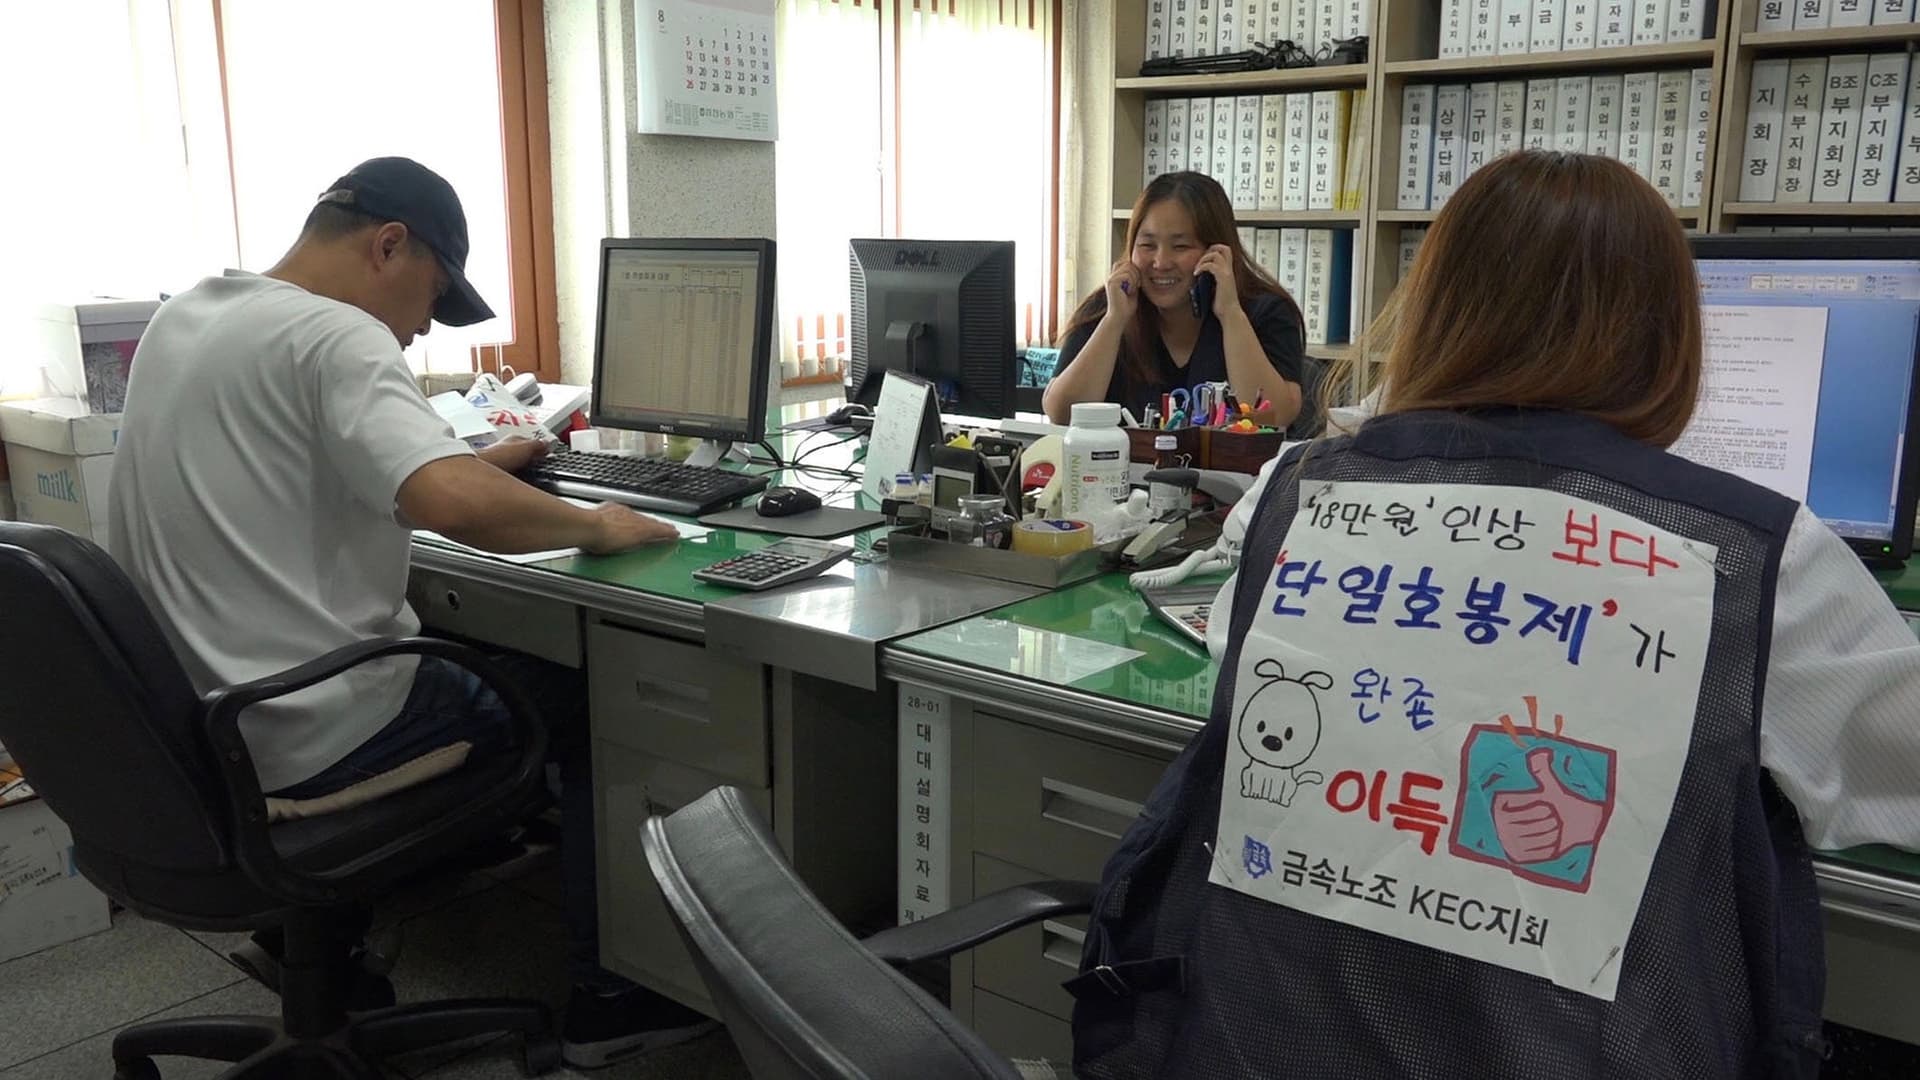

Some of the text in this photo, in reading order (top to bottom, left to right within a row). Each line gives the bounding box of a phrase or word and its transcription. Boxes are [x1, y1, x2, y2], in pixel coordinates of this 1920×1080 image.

[658, 10, 665, 22] 8
[1297, 0, 1305, 41] 회계자
[1323, 0, 1331, 39] 회계자
[1607, 5, 1621, 34] 자료
[1764, 2, 1781, 20] 원
[1803, 0, 1820, 18] 원
[1240, 111, 1253, 190] 사내수발신
[1265, 110, 1277, 189] 사내수발신
[1289, 109, 1303, 190] 사내수발신
[1315, 111, 1329, 192] 사내수발신
[1437, 108, 1456, 186] 상부단체
[1750, 88, 1775, 176] 지회장
[1785, 73, 1811, 193] 수석부지회장
[1823, 75, 1858, 188] B조부지회장
[1862, 72, 1898, 187] C조부지회장
[1904, 78, 1920, 185] 부장
[1441, 503, 1536, 551] 인상
[1552, 508, 1680, 577] 보다
[915, 722, 932, 904] 대대설명회자료
[1325, 769, 1449, 856] 이득
[1282, 849, 1398, 909] 금속노조
[1408, 884, 1549, 950] KEC지회
